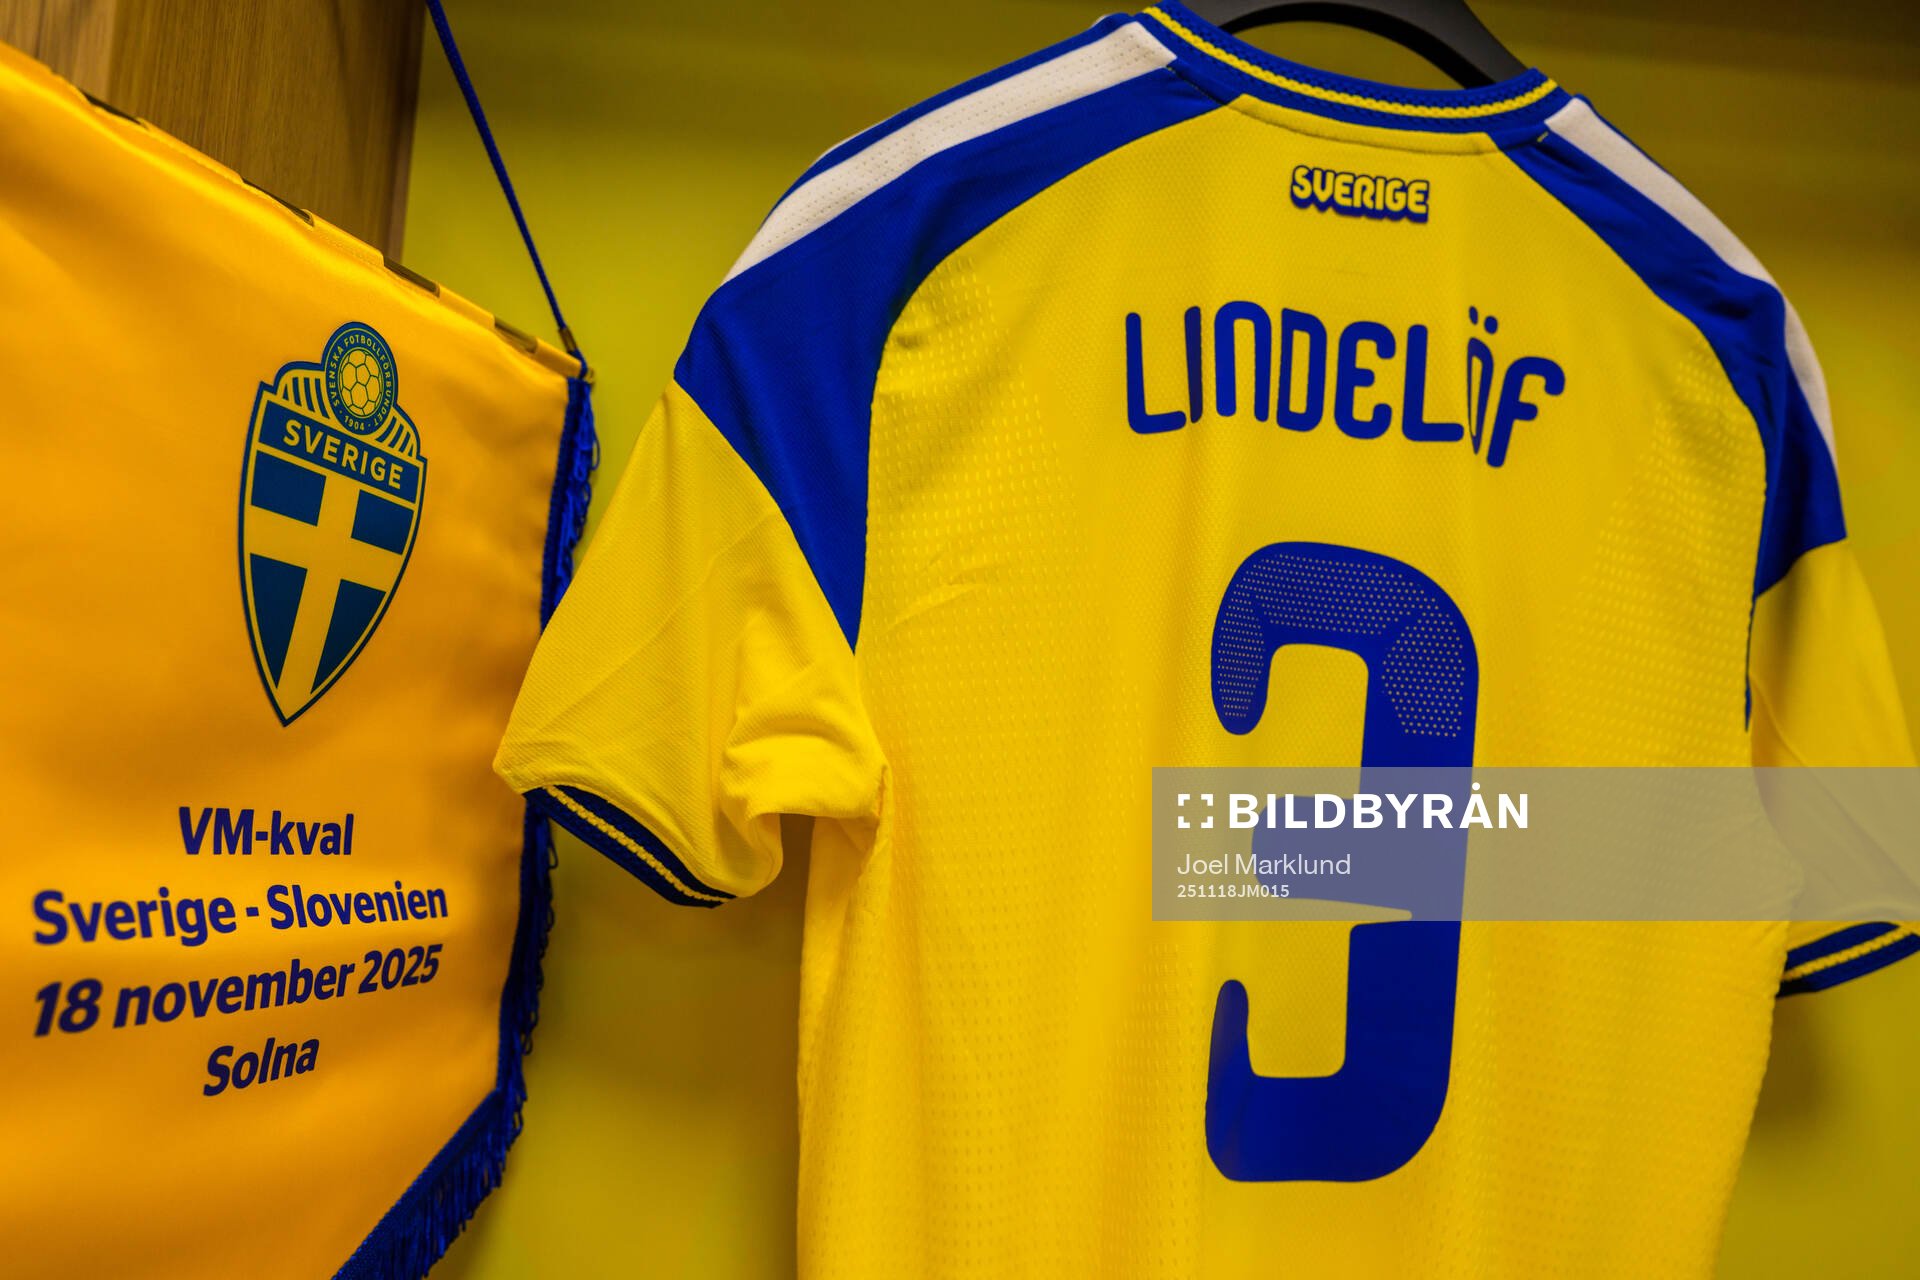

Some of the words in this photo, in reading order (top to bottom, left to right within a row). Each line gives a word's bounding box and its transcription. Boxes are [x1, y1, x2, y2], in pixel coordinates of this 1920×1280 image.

[1290, 165, 1430, 223] SVERIGE
[329, 345, 344, 408] SVENSKA
[1125, 300, 1566, 468] LINDELÖF
[284, 420, 404, 489] SVERIGE
[344, 415, 365, 431] 1904
[179, 806, 355, 855] VM-kval
[1205, 541, 1479, 1183] 3
[33, 887, 237, 946] Sverige
[266, 881, 448, 930] Slovenien
[33, 977, 103, 1038] 18
[112, 958, 355, 1029] november
[358, 943, 443, 995] 2025
[202, 1037, 320, 1097] Solna
